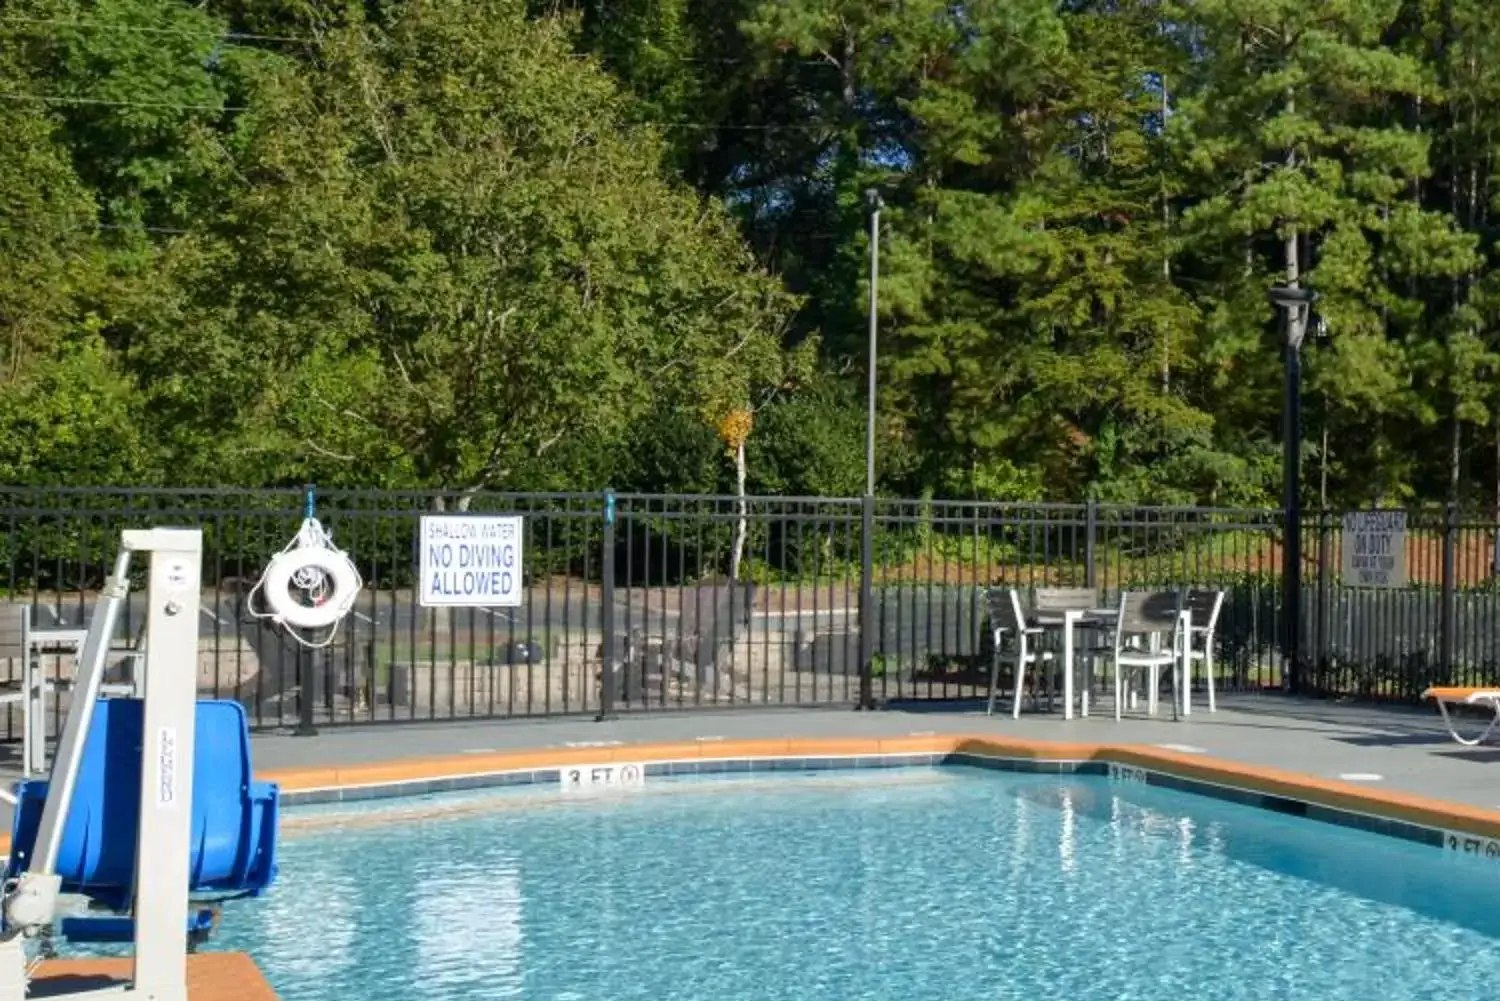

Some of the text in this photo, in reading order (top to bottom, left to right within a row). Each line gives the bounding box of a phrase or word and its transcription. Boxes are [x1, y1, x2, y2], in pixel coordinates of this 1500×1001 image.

[429, 522, 515, 540] SHALLOW WATER
[429, 543, 514, 568] NO DIVING
[431, 571, 513, 595] ALLOWED
[591, 768, 614, 784] FT
